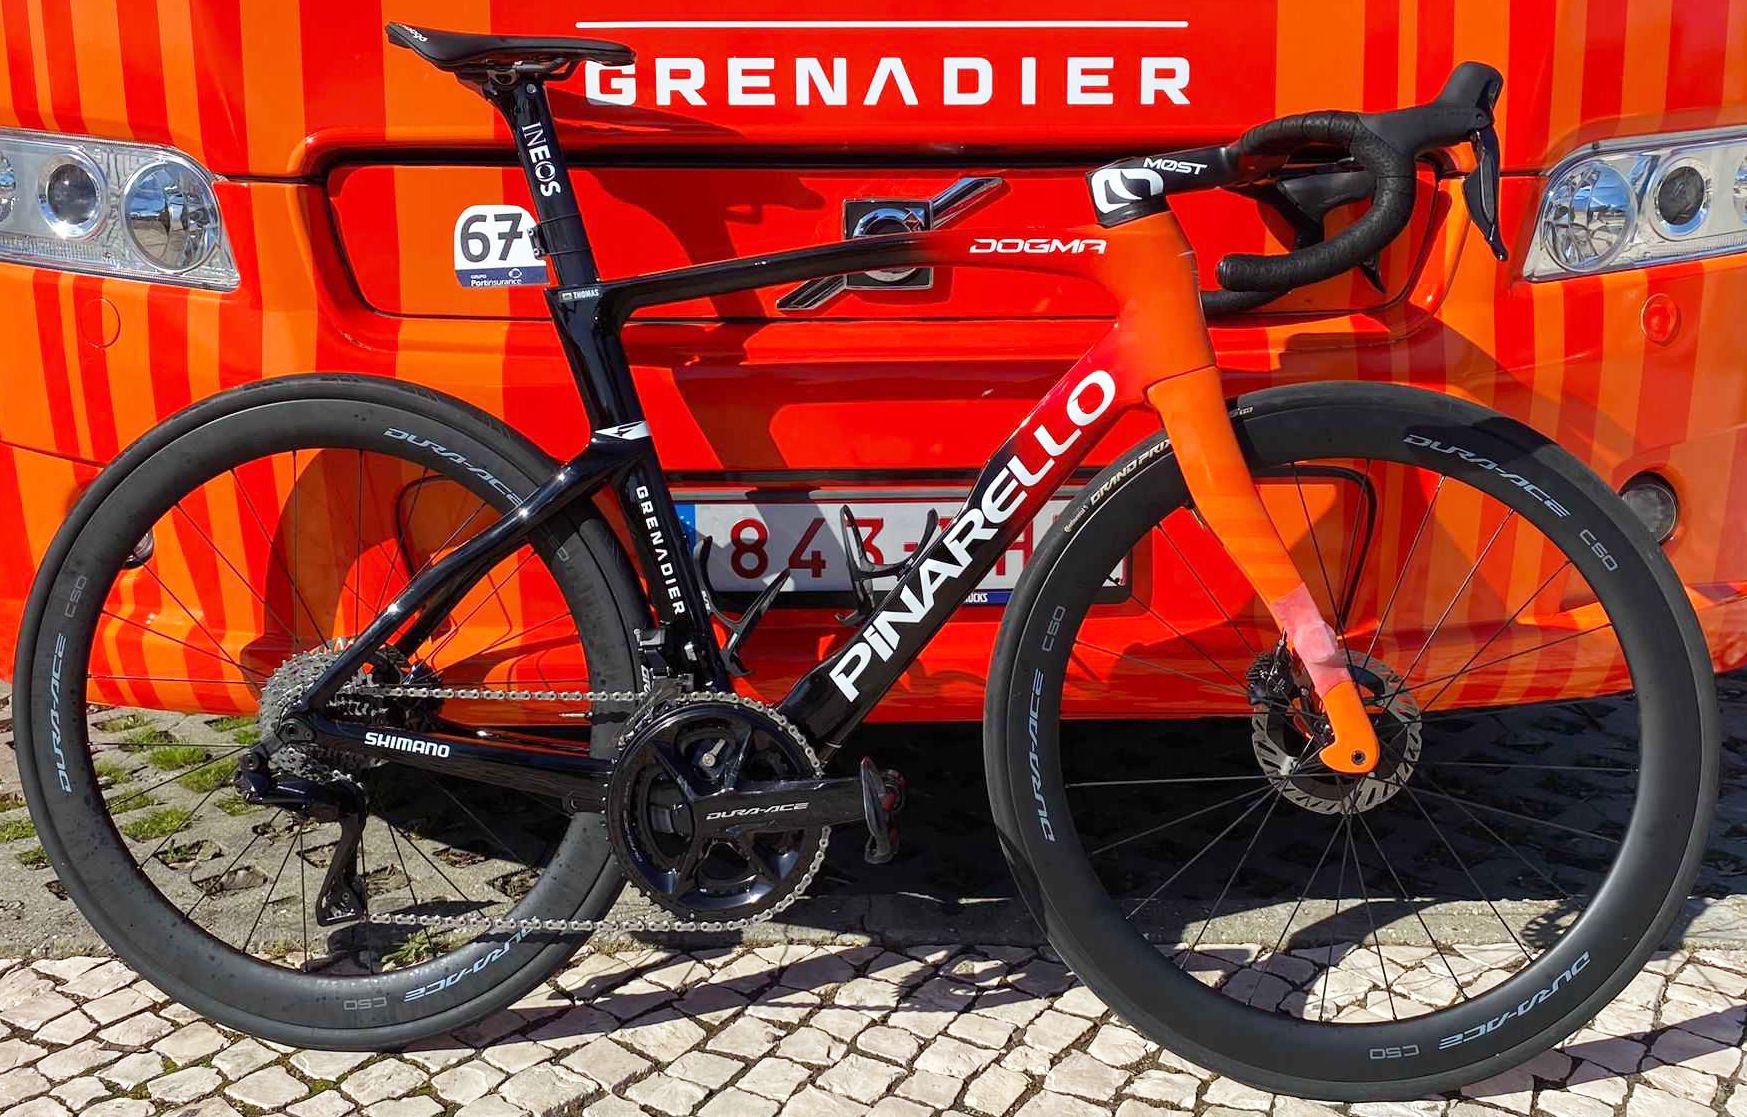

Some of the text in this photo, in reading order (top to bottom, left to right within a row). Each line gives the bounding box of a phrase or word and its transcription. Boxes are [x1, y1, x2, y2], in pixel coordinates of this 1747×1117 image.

[585, 56, 1191, 106] GRENADIER
[521, 122, 561, 197] INEOS
[460, 212, 523, 263] 67
[969, 238, 1107, 254] DOGMA
[470, 278, 522, 287] Portinsurance
[573, 288, 600, 300] THOMAS
[383, 427, 524, 507] DURA-ACE
[1402, 434, 1619, 572] DURA-ACE C50
[635, 485, 686, 615] GRENADIER
[829, 369, 1116, 703] PINARELLO
[965, 592, 988, 603] UCKS
[50, 576, 87, 794] DURA-ACE C50
[364, 731, 451, 759] SHIMANO
[1028, 605, 1067, 843] DURA-ACE C50
[706, 802, 810, 821] DURA-ACE
[343, 997, 387, 1011] C50
[1369, 951, 1592, 1060] DURA-ACE C50
